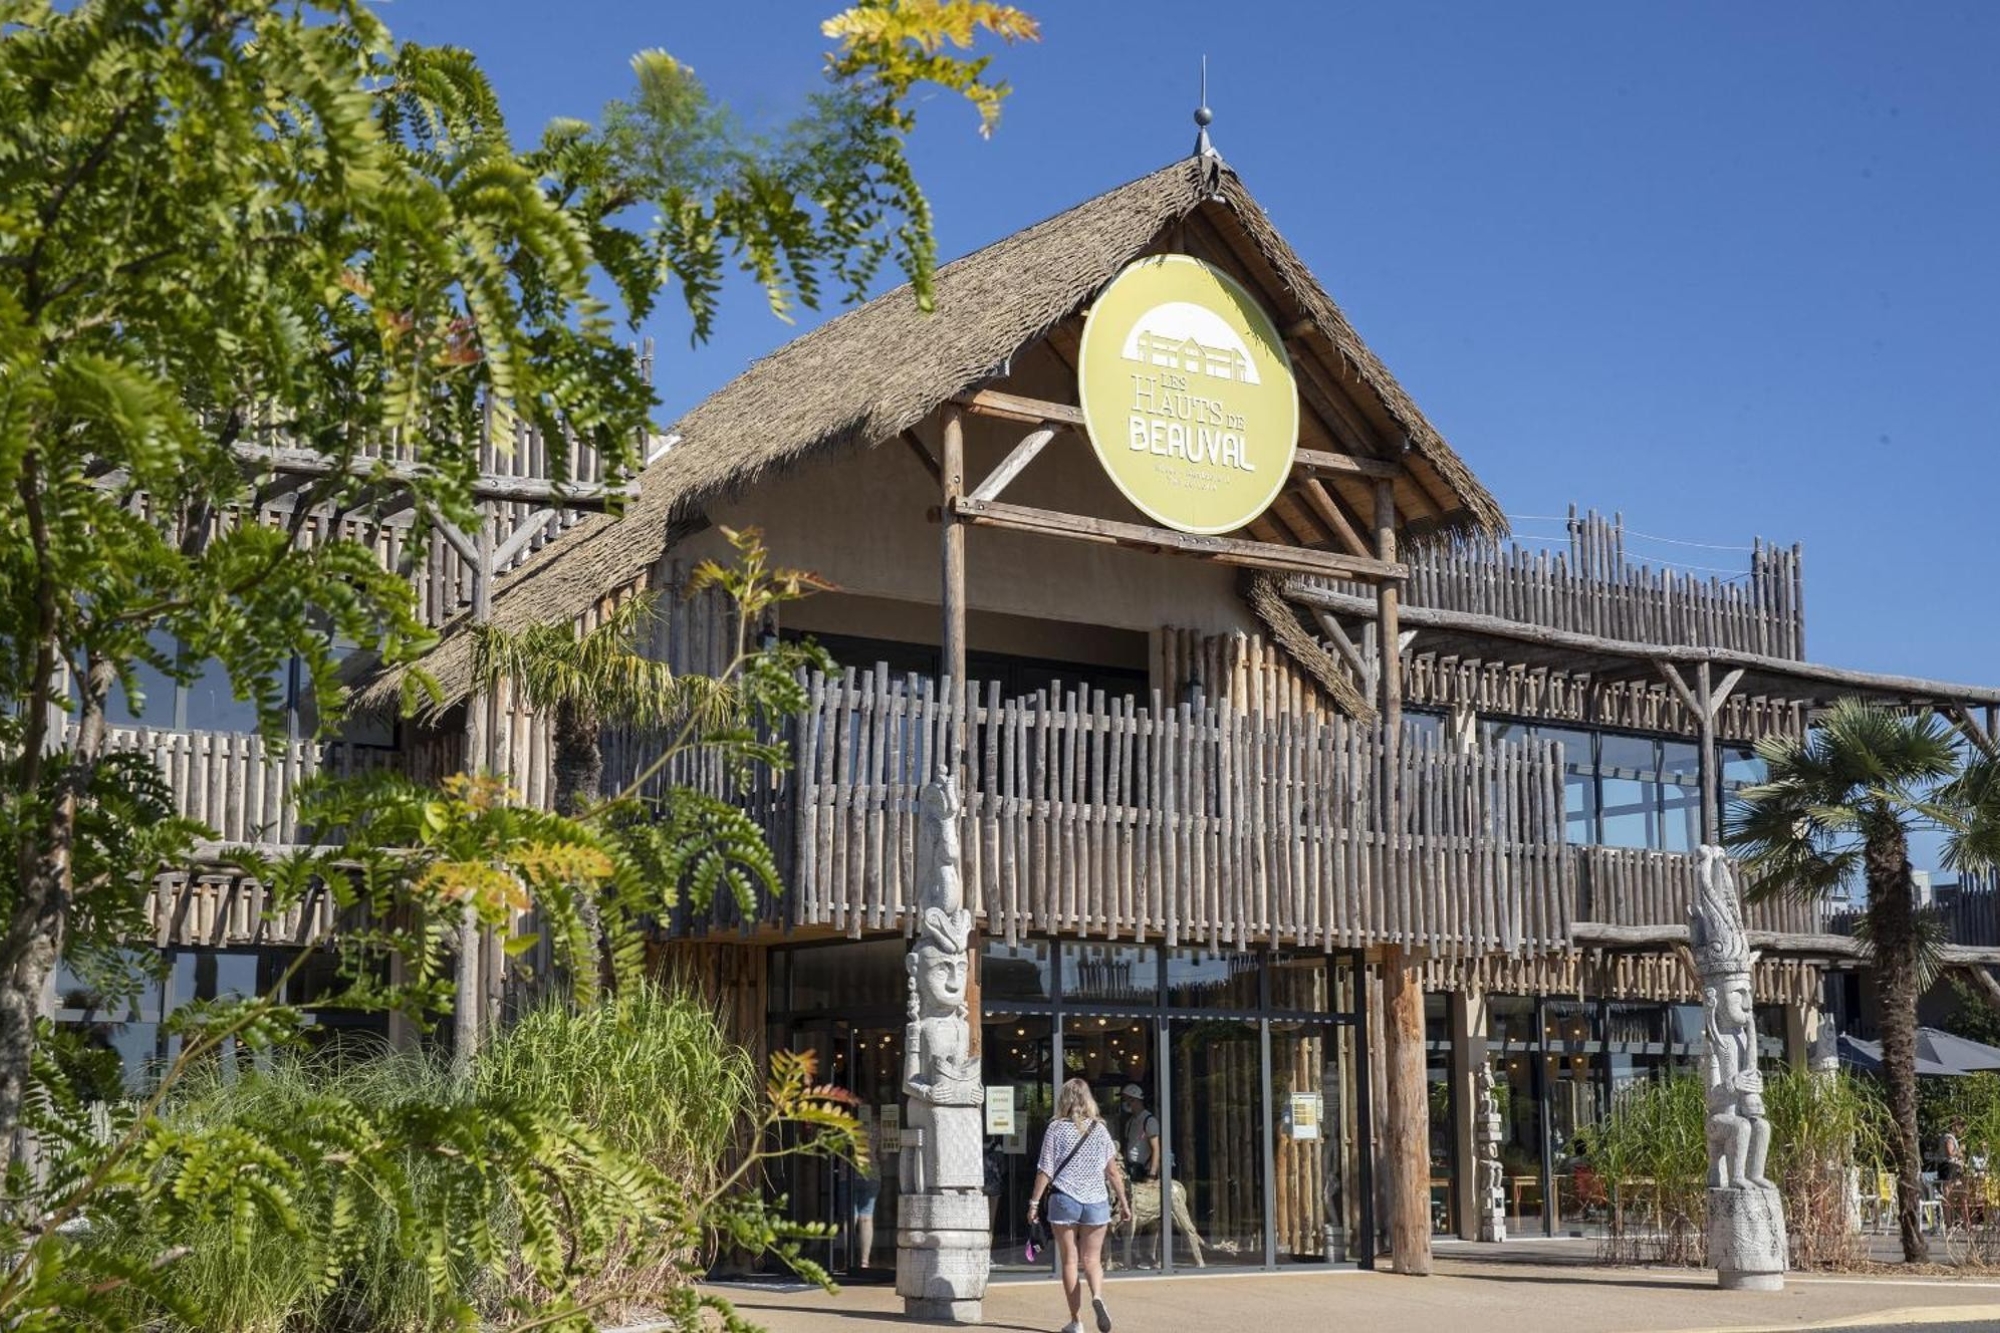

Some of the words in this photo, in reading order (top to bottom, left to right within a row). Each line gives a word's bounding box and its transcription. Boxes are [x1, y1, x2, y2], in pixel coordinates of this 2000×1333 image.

[1130, 374, 1223, 426] HAUTS
[1226, 413, 1245, 432] DE
[1161, 373, 1186, 391] LES
[1128, 415, 1256, 473] BEAUVAL
